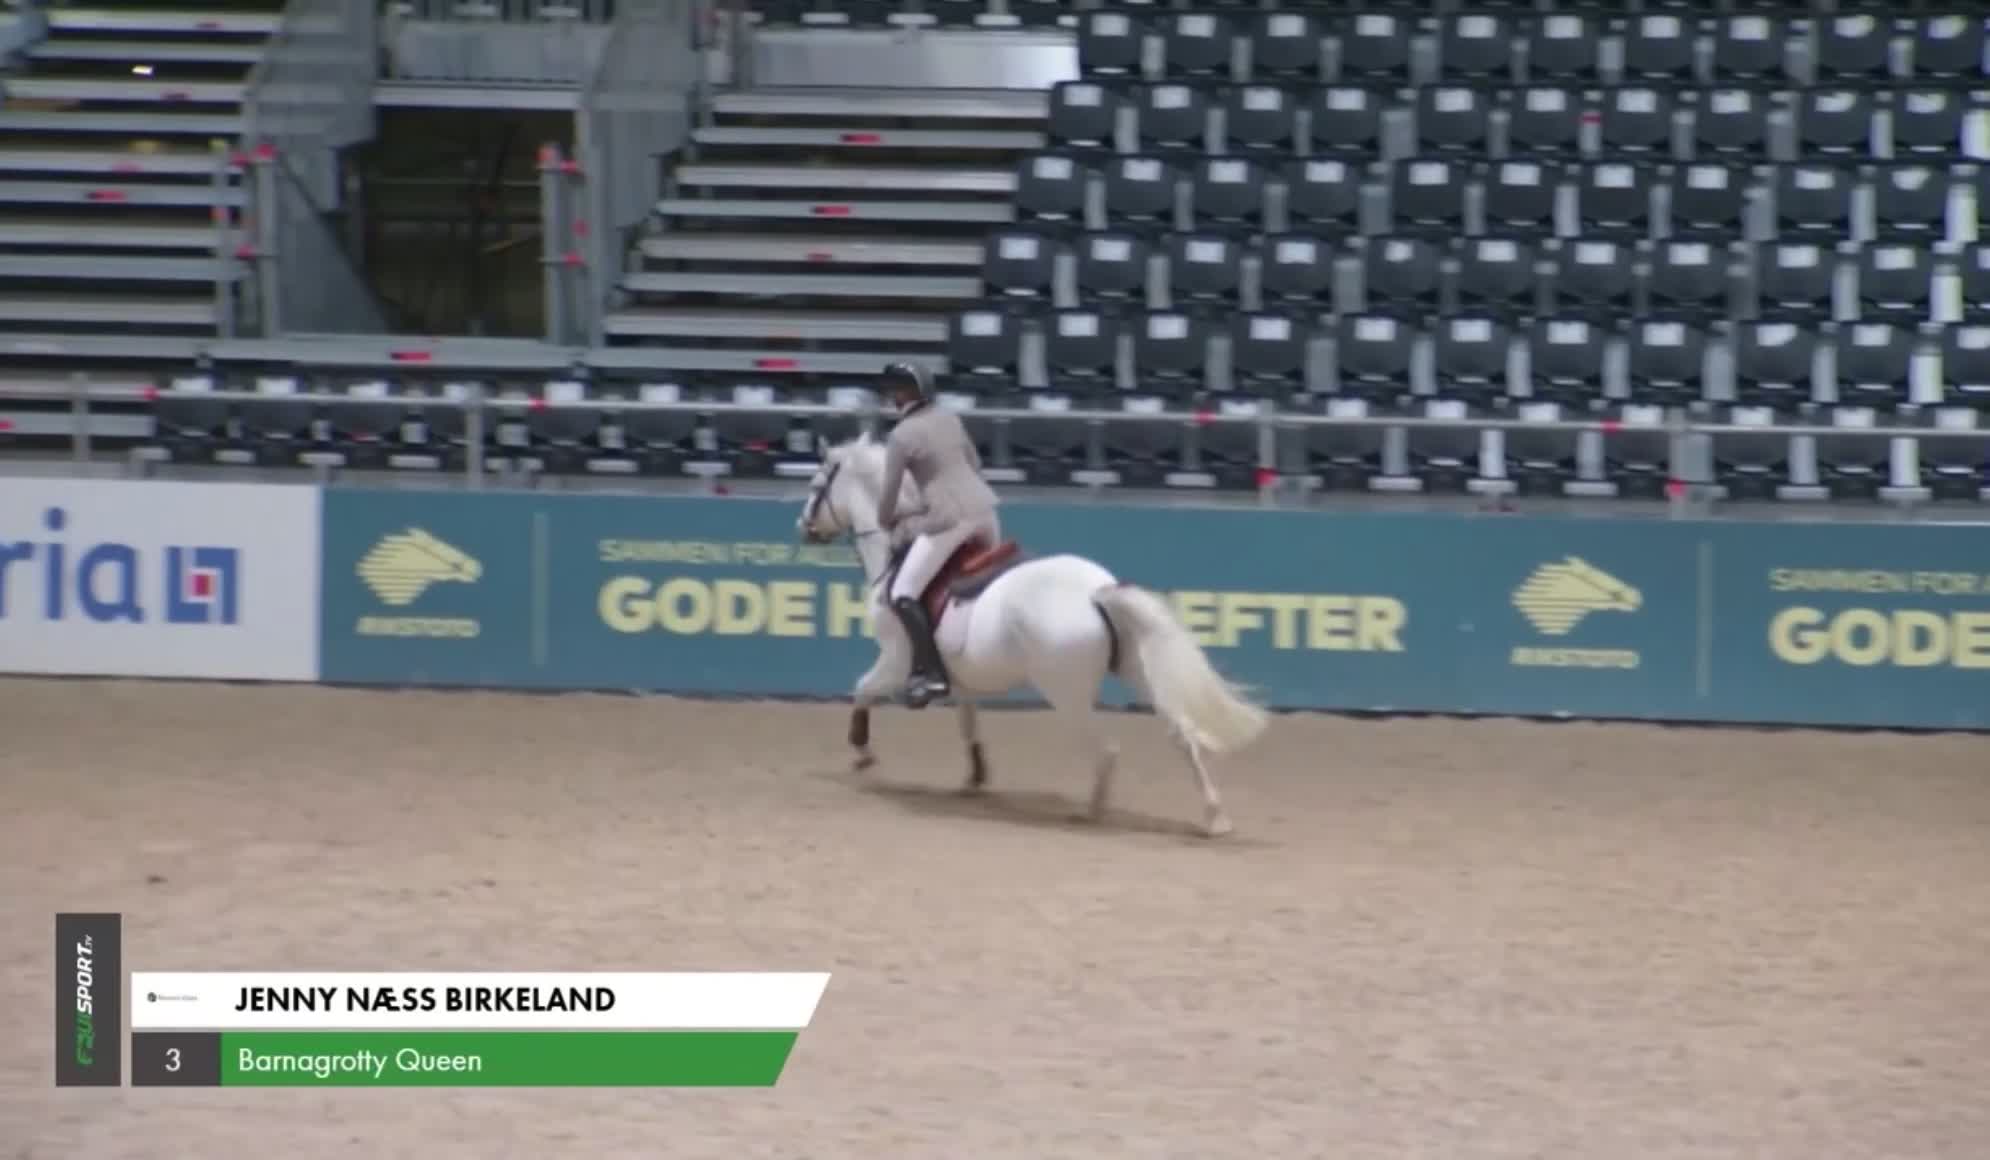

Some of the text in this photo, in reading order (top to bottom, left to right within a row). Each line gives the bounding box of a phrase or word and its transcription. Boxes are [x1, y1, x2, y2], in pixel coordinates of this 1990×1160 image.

[599, 576, 1407, 652] GODE H EFTER
[1768, 606, 1990, 668] GODE
